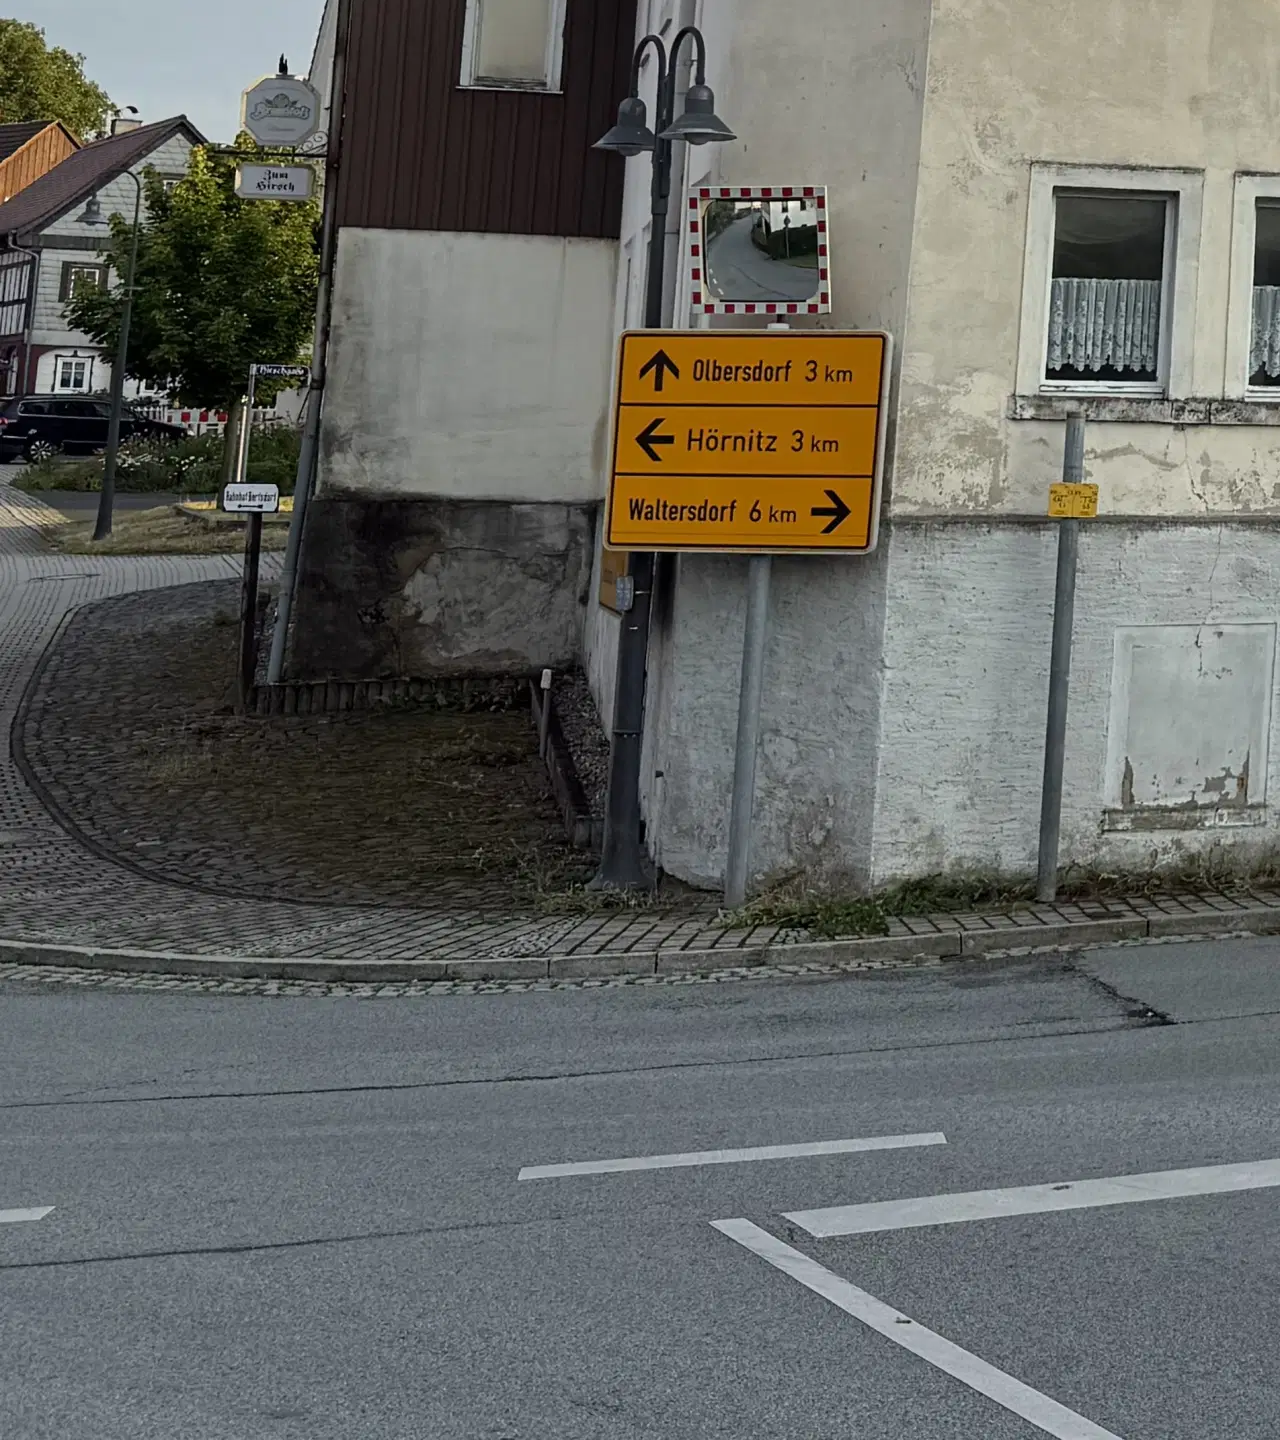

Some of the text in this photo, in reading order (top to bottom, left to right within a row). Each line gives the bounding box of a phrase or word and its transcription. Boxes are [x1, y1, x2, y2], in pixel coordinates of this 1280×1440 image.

[256, 180, 295, 192] Hirsch
[263, 169, 289, 181] Zum
[693, 359, 853, 383] Olbersdorf 3 km
[687, 428, 839, 453] Hörnitz 3 km
[628, 497, 797, 523] Waltersdorf 6 km
